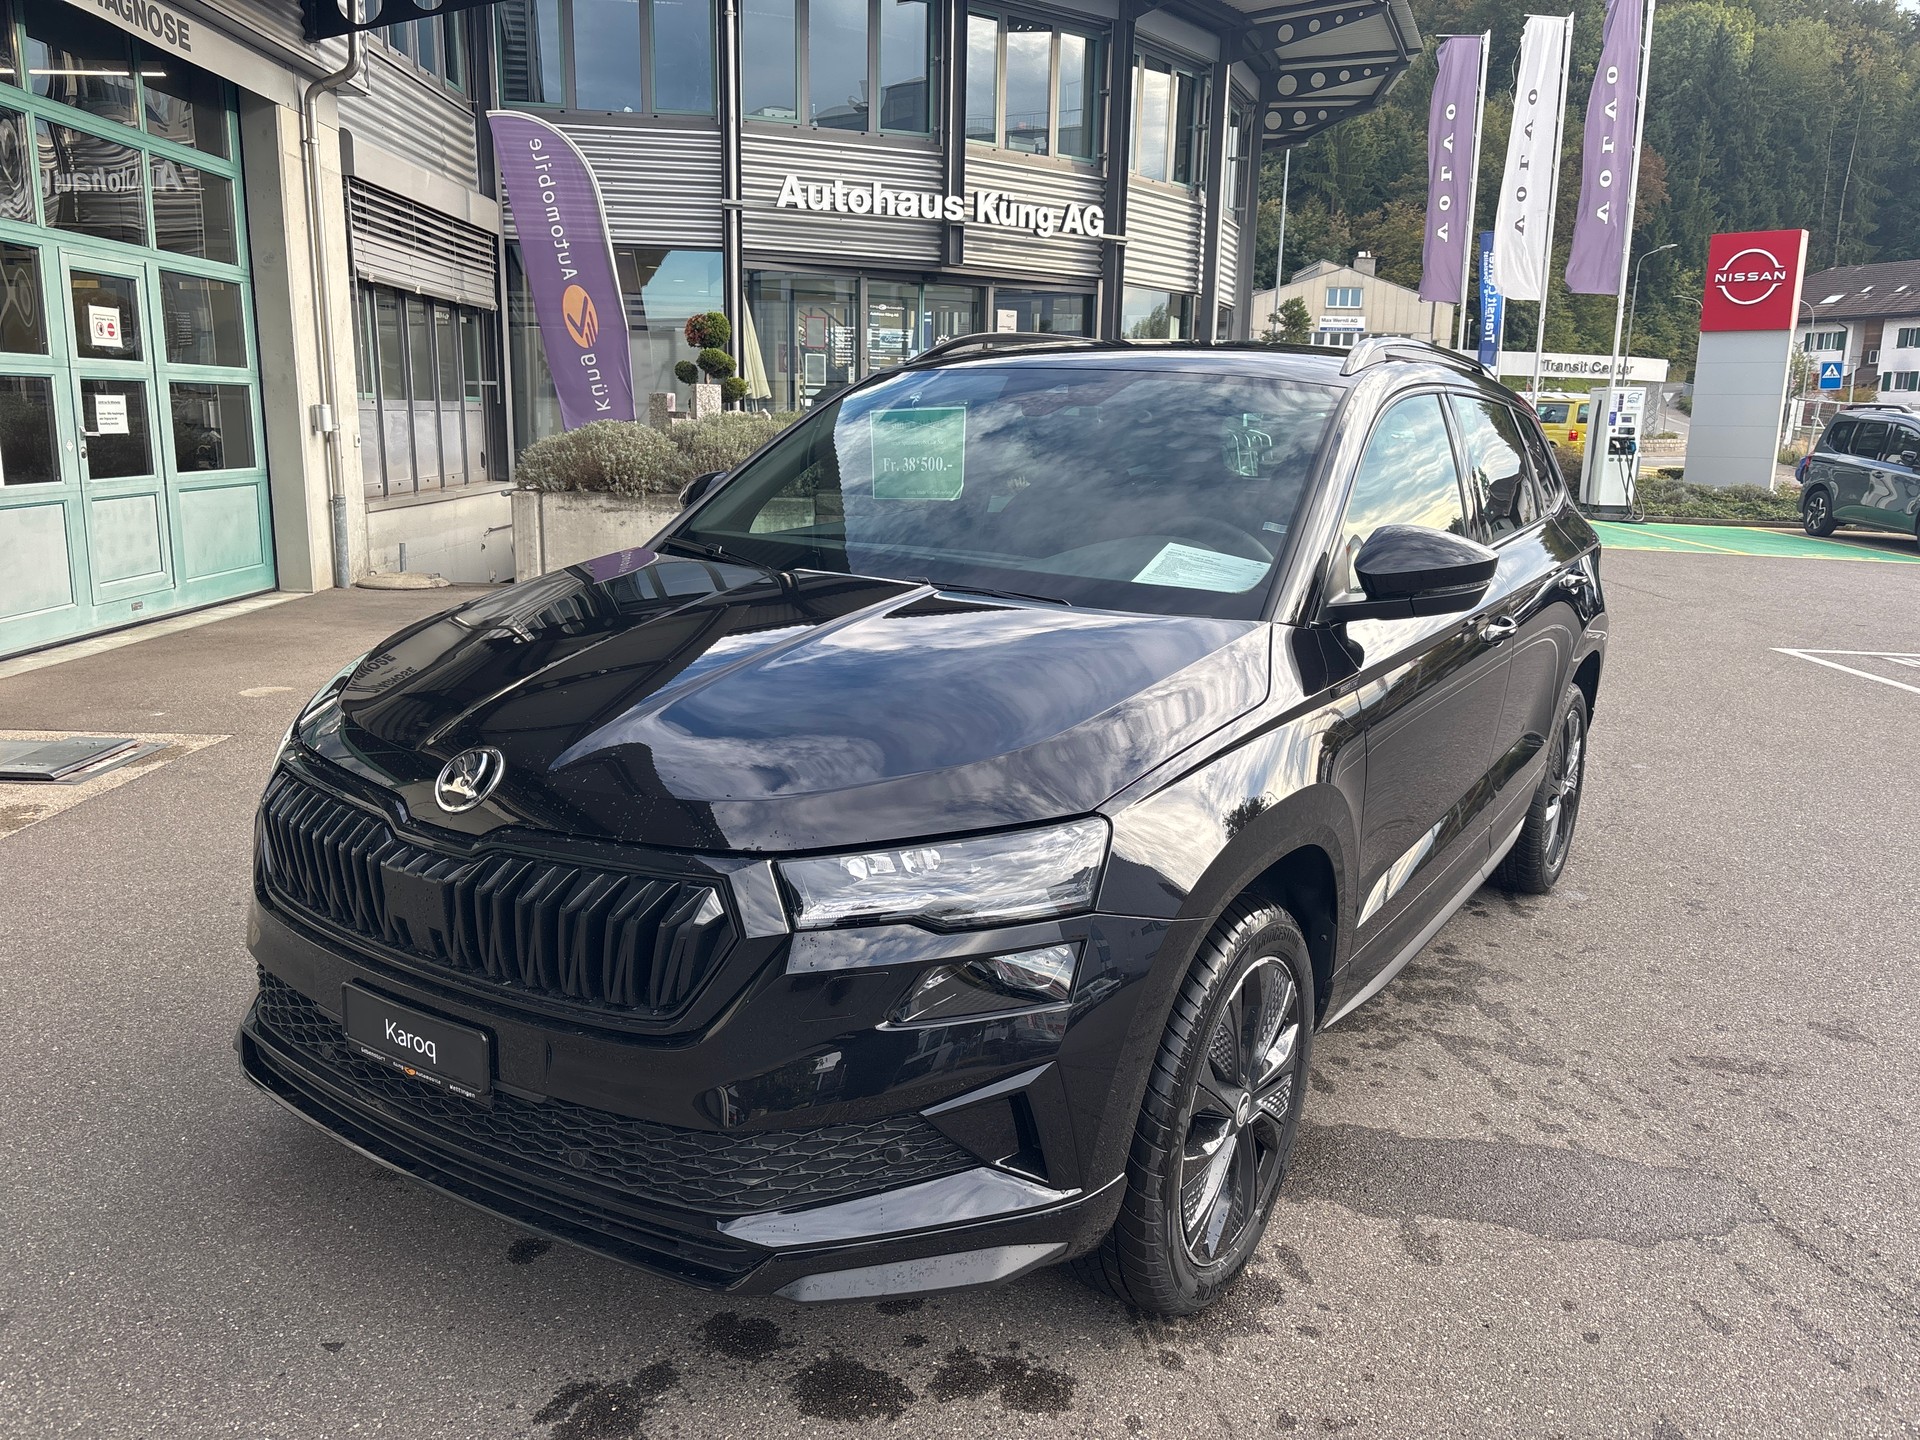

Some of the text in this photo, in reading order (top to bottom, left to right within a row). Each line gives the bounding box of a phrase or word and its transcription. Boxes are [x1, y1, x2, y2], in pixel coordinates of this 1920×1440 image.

[96, 0, 191, 52] AGNOSE
[776, 175, 1104, 237] Autohaus Küng AG
[1714, 270, 1786, 283] NISSAN
[1543, 359, 1588, 373] Transit
[882, 457, 899, 472] Fr.
[385, 1018, 437, 1065] Karoq
